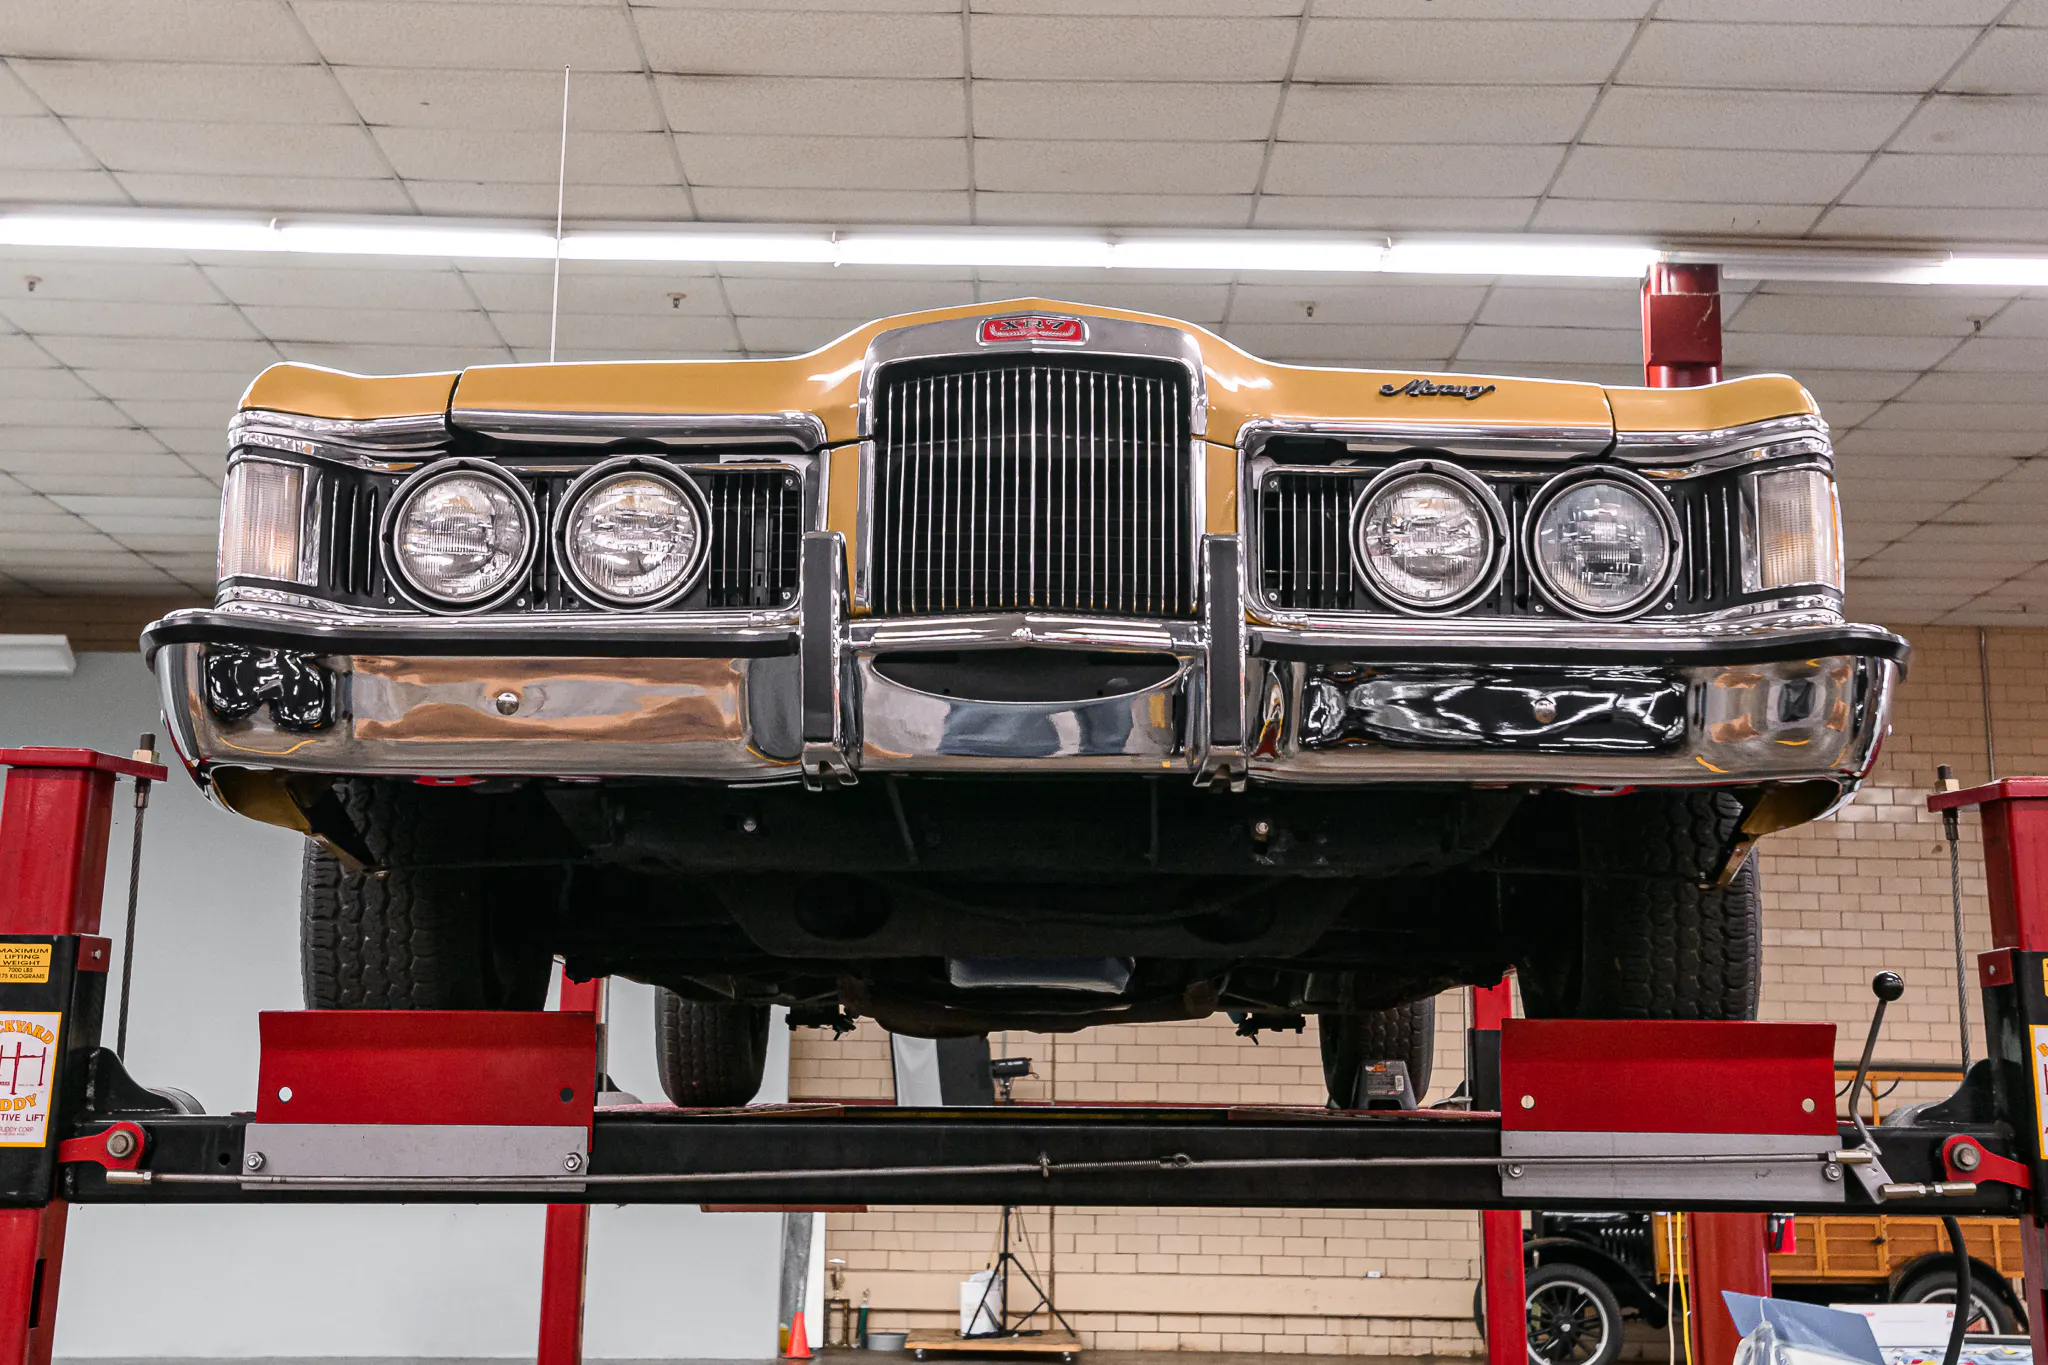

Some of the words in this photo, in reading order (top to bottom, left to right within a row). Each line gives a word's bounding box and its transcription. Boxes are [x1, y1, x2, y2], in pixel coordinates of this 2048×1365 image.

[1000, 320, 1065, 331] XR7
[1379, 379, 1496, 401] Mercury
[26, 1113, 45, 1121] LIFT
